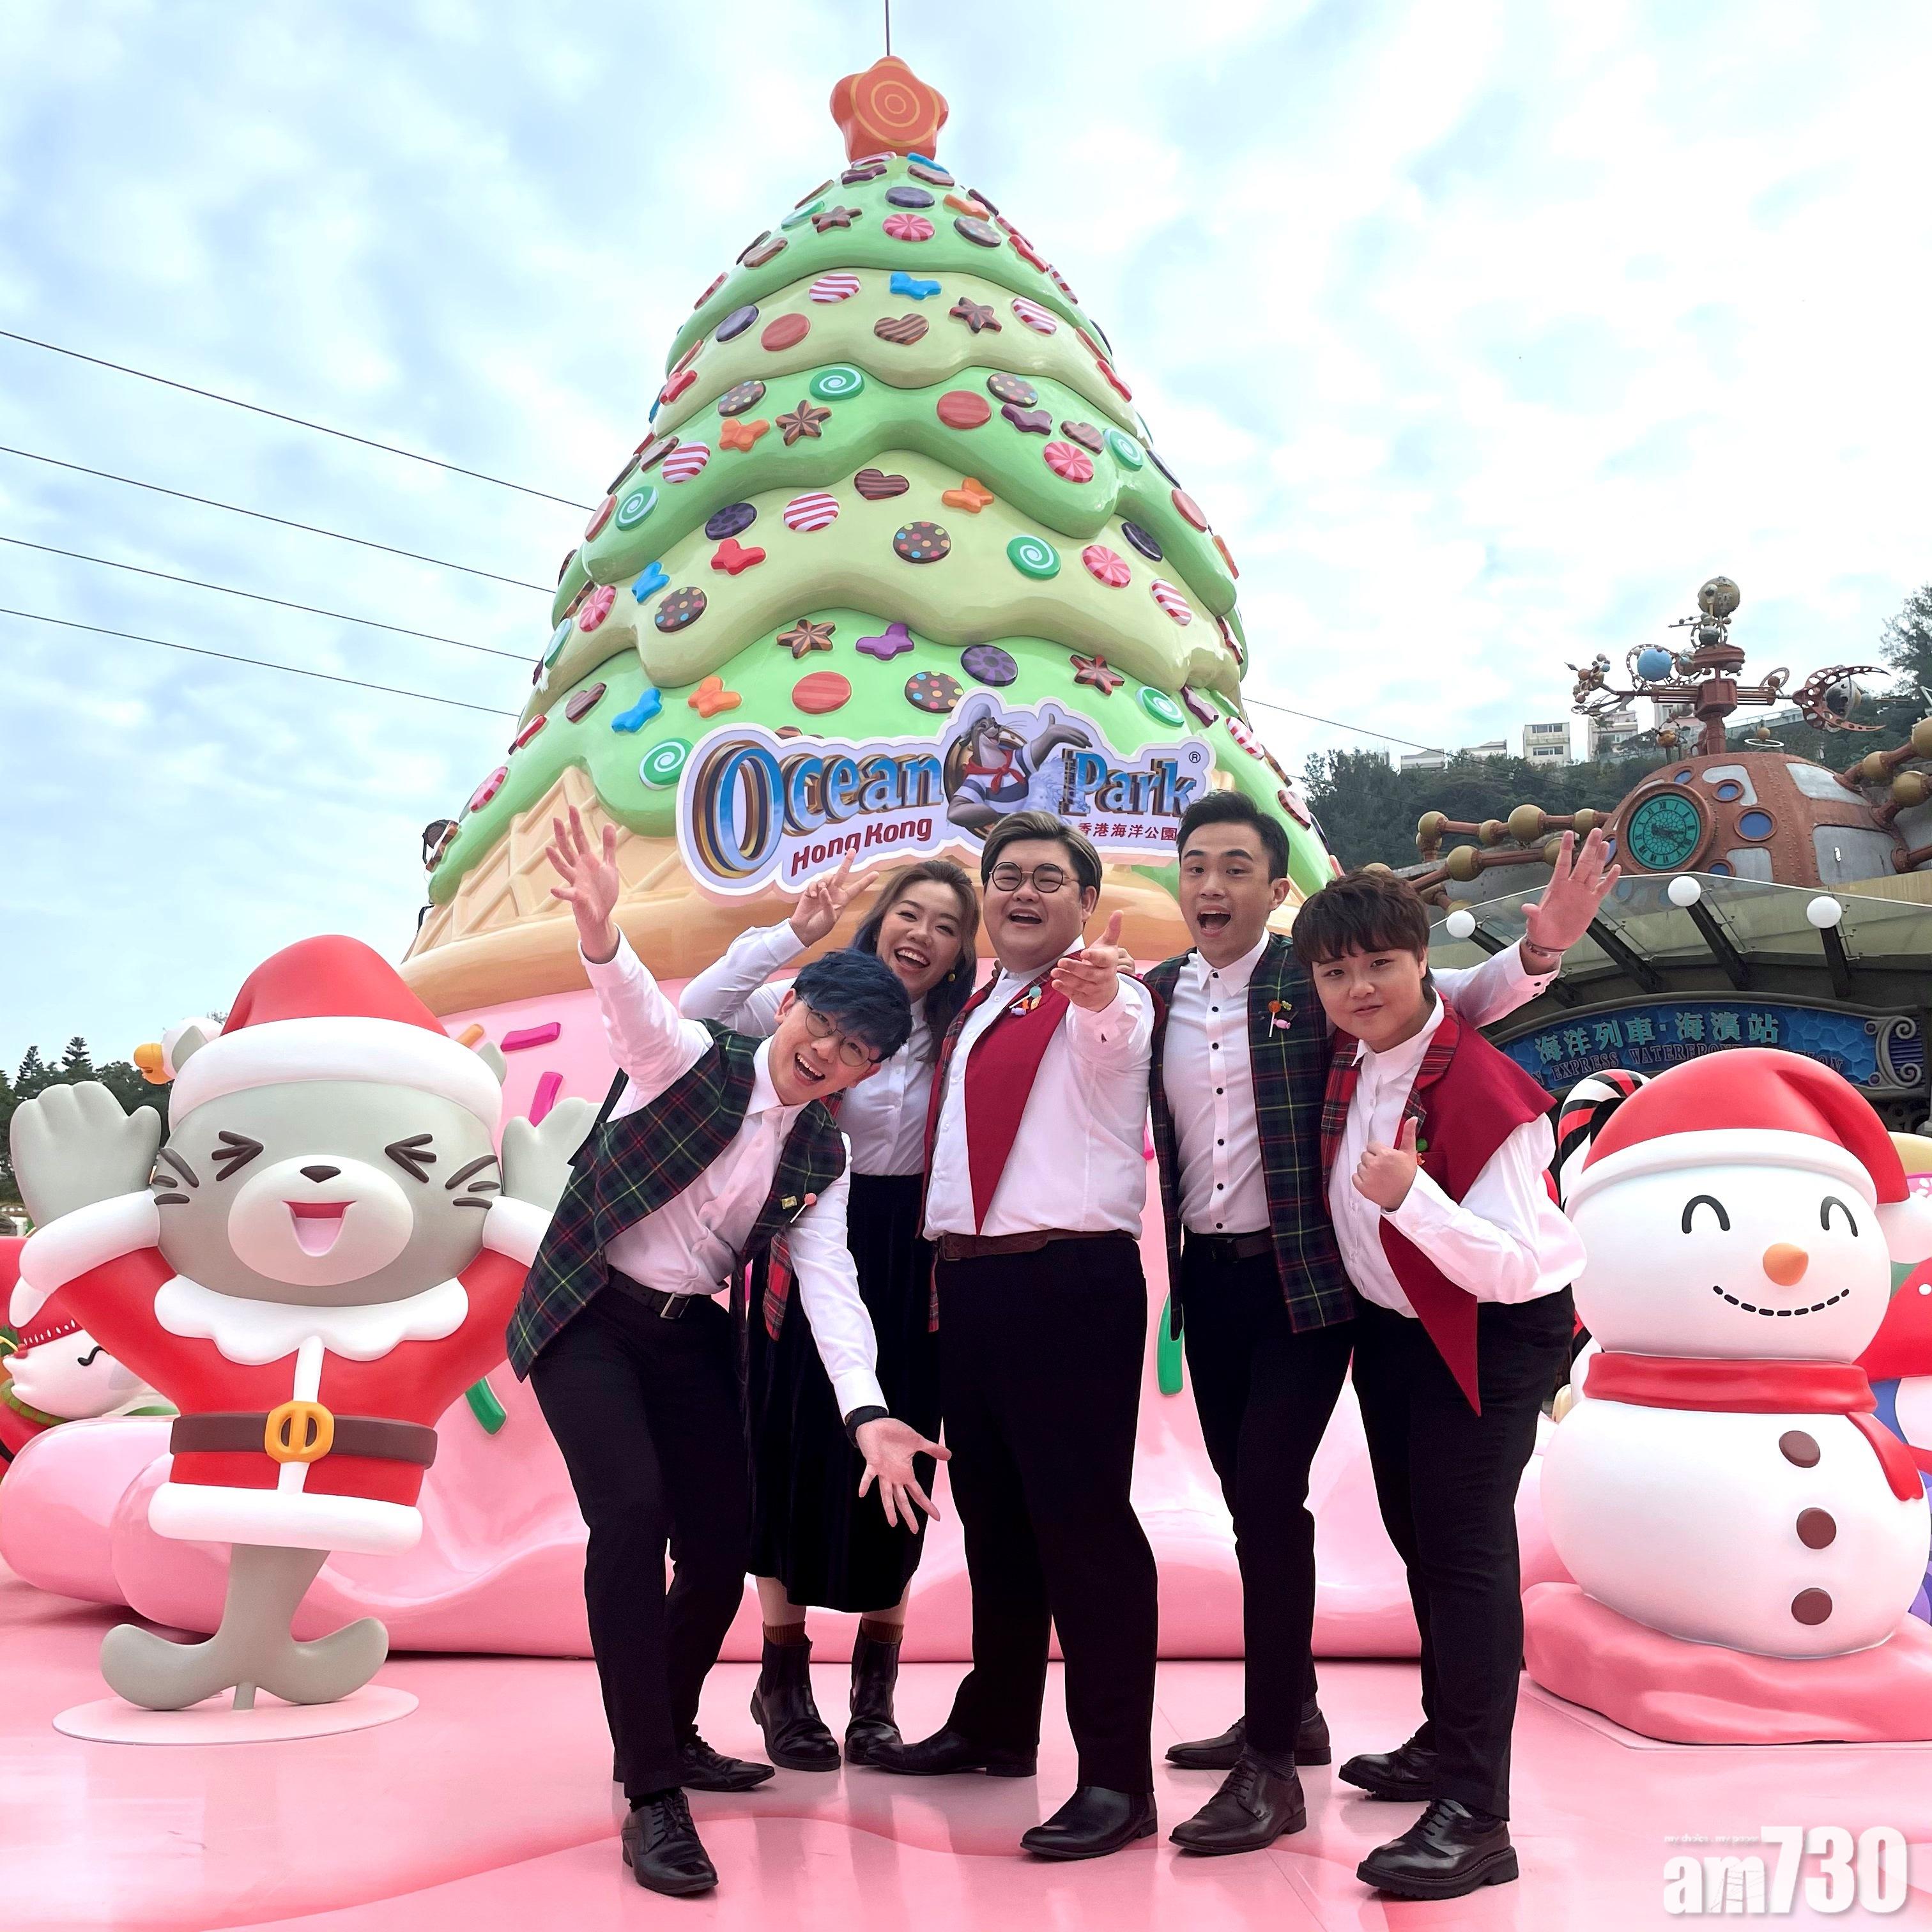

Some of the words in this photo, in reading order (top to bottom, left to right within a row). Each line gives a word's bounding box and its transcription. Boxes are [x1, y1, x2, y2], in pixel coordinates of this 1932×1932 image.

[693, 740, 944, 878] Ocean
[1061, 748, 1197, 817] Park
[791, 832, 861, 877] Hong
[864, 818, 932, 847] Kong
[1551, 1052, 1619, 1081] EXPRESS
[1629, 1043, 1744, 1064] WATERFRO
